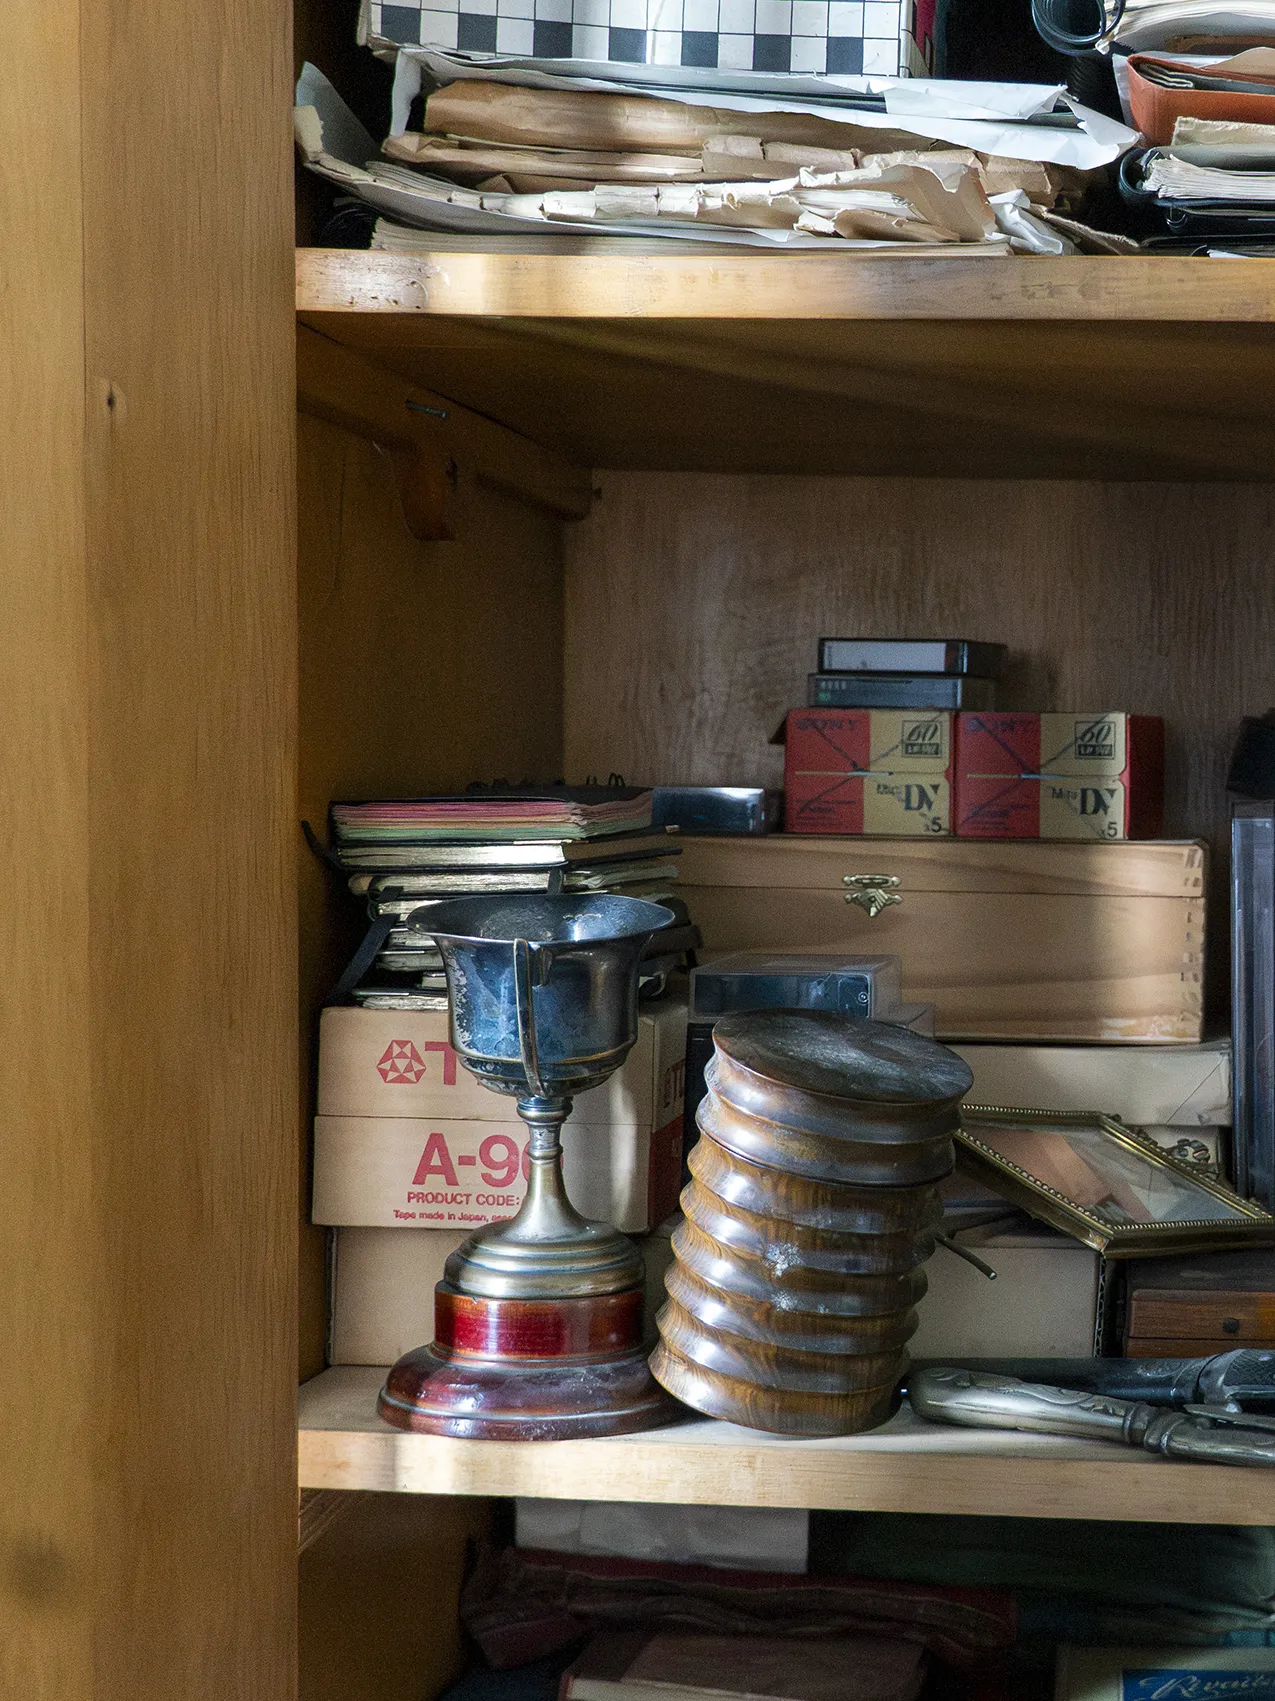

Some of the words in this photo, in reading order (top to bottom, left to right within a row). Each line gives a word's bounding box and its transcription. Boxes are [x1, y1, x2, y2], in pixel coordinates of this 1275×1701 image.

[1079, 723, 1112, 743] 60
[904, 784, 940, 812] DV
[1080, 787, 1118, 816] DV
[407, 1191, 473, 1205] PRODUCT
[476, 1193, 520, 1206] CODE:
[393, 1209, 417, 1221] Tape
[419, 1211, 445, 1221] made
[447, 1212, 456, 1221] in
[458, 1212, 489, 1223] Japan,
